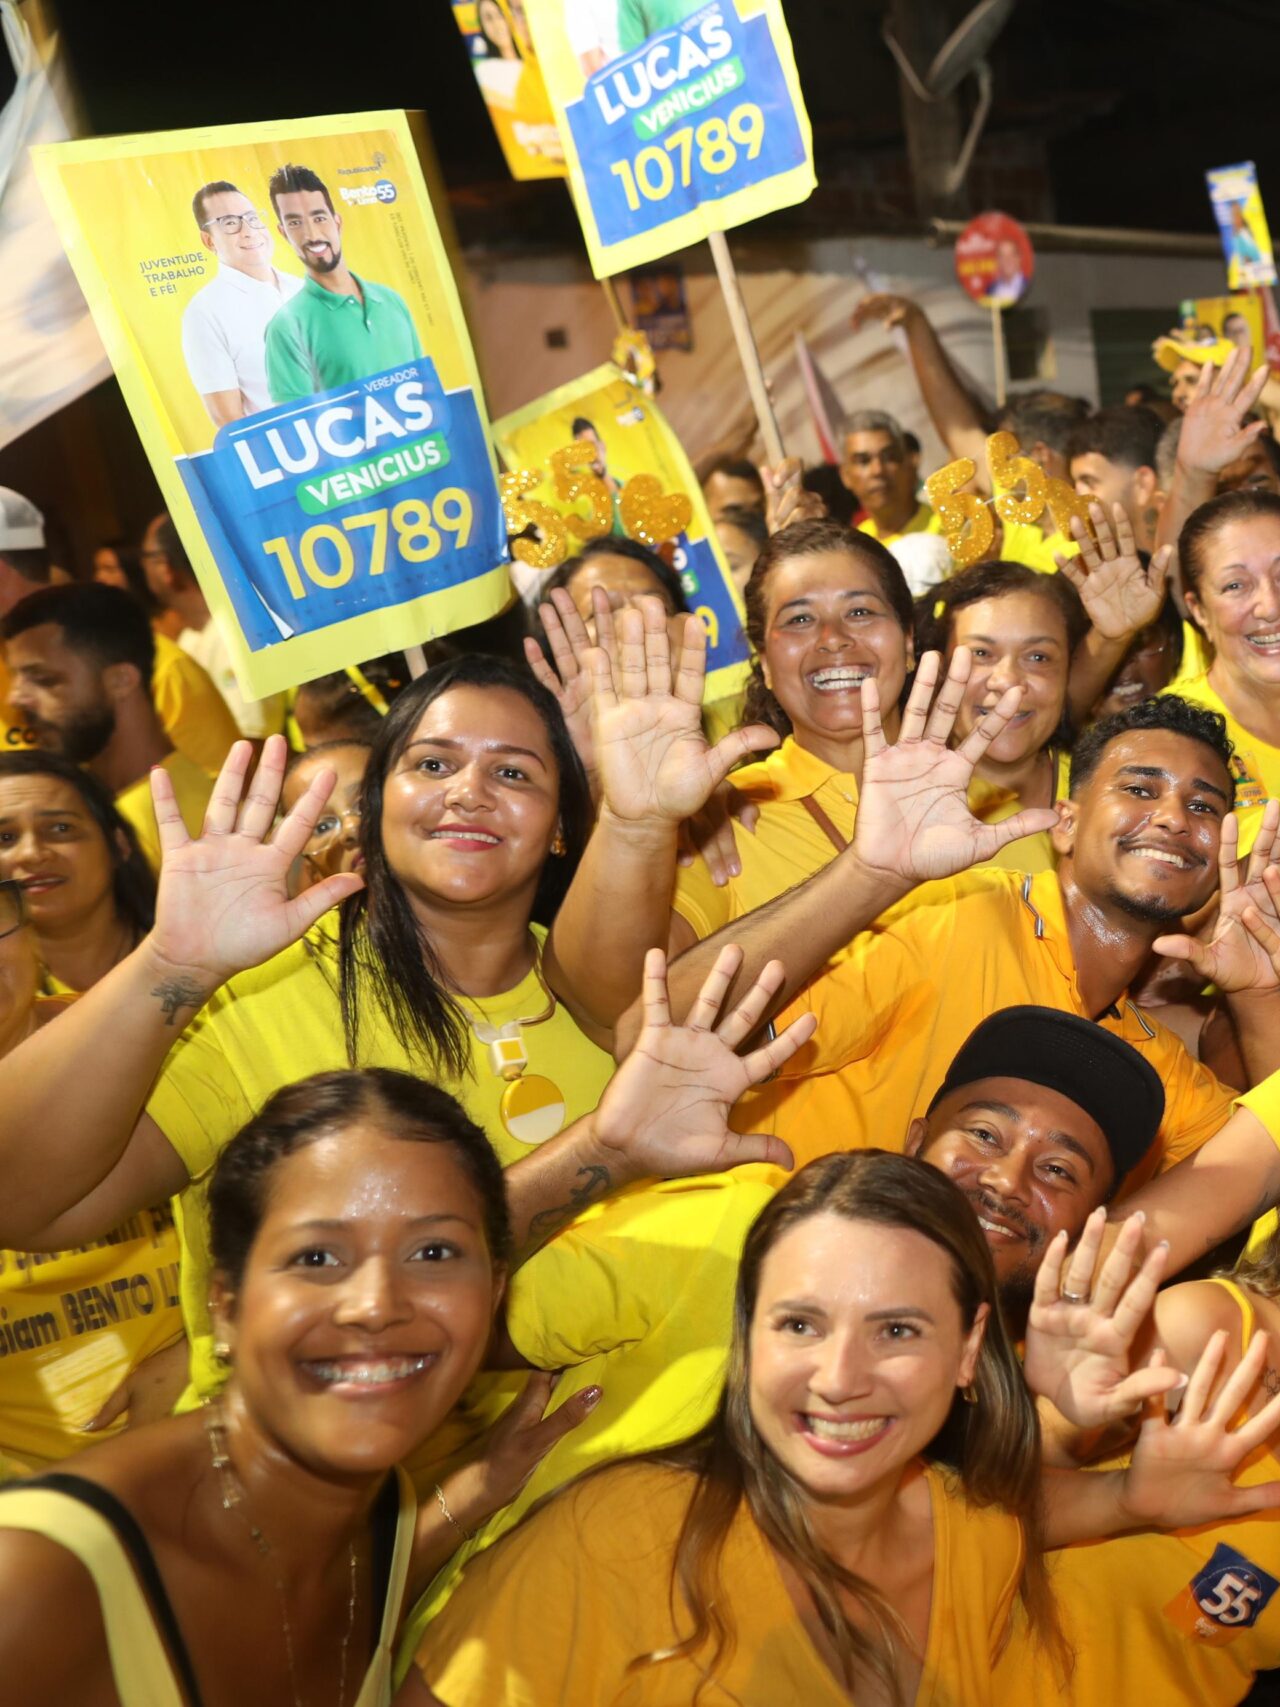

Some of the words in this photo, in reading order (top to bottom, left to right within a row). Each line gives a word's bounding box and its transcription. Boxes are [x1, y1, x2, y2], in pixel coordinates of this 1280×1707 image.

[593, 15, 732, 125] LUCAS
[638, 63, 738, 133] VENICIUS
[609, 103, 765, 211] 10789
[376, 183, 395, 200] 55
[139, 252, 208, 274] JUVENTUDE,
[144, 265, 205, 284] TRABALHO
[149, 287, 158, 297] E
[160, 282, 177, 295] FÉ!
[364, 367, 419, 393] VEREADOR
[233, 382, 434, 490] LUCAS
[305, 440, 441, 506] VENICIUS
[262, 487, 474, 600] 10789
[61, 1274, 154, 1336] BENTO
[1199, 1572, 1262, 1624] 55
